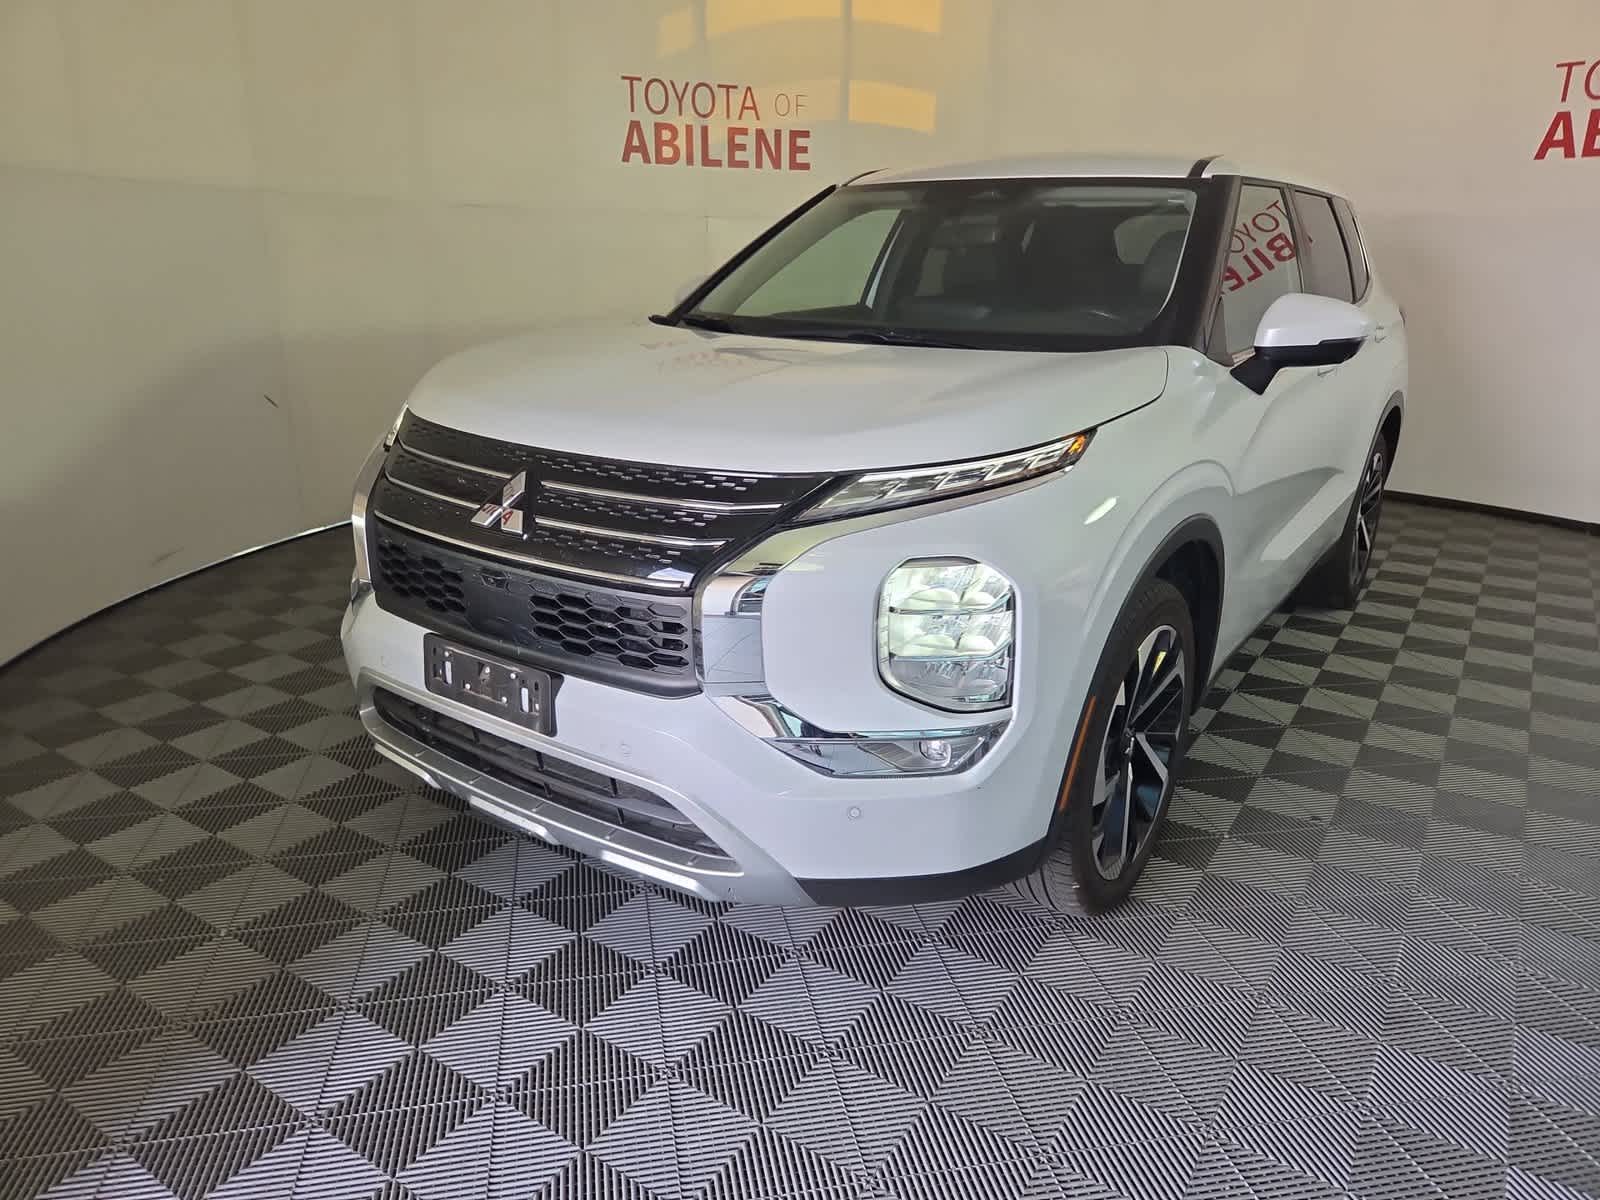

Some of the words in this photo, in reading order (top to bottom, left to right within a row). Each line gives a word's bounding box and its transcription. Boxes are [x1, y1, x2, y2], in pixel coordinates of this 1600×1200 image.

[621, 75, 761, 121] TOYOTA
[774, 92, 809, 118] OF
[621, 119, 811, 171] ABILENE
